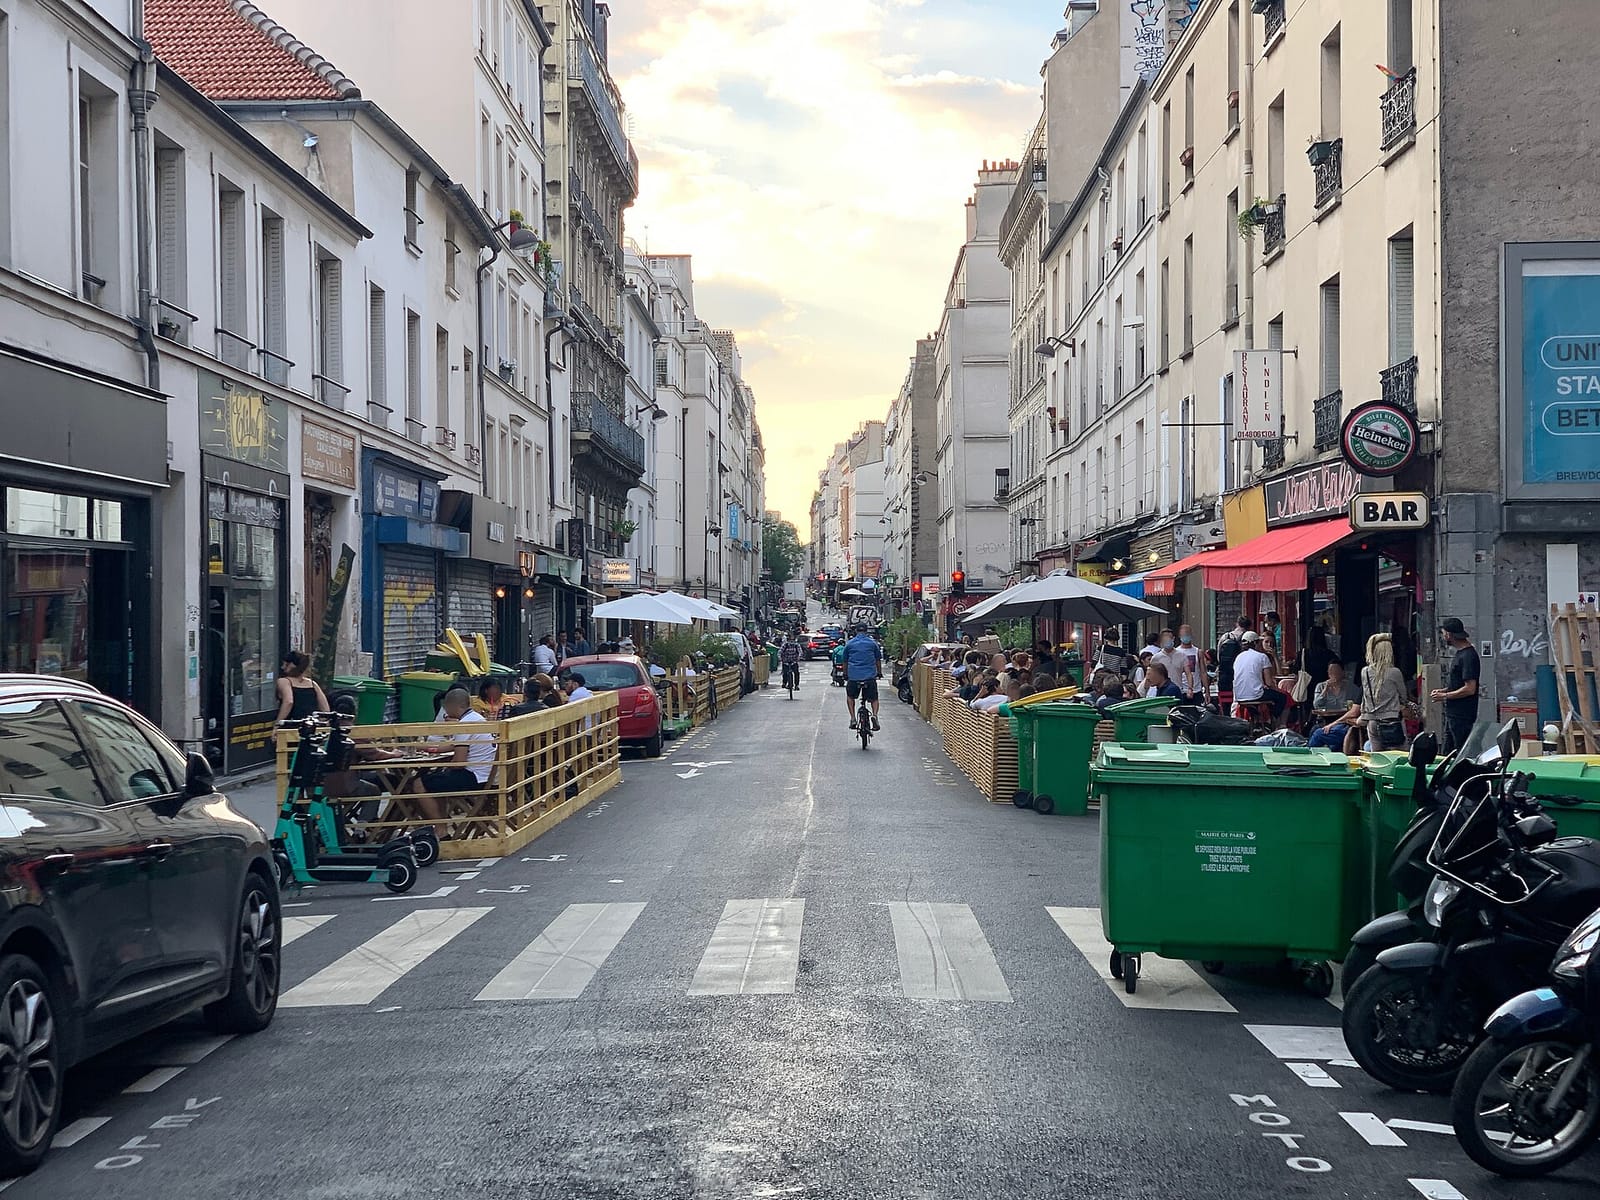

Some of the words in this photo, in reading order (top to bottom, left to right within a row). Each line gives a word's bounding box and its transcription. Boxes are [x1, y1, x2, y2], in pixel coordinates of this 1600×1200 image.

[1241, 352, 1249, 430] RESTAURANT
[1263, 357, 1271, 422] INDIEN
[1556, 375, 1600, 395] STA
[1558, 408, 1600, 427] BET
[1355, 427, 1407, 452] Heineken
[1363, 501, 1419, 522] BAR
[1228, 1094, 1333, 1173] MOTO
